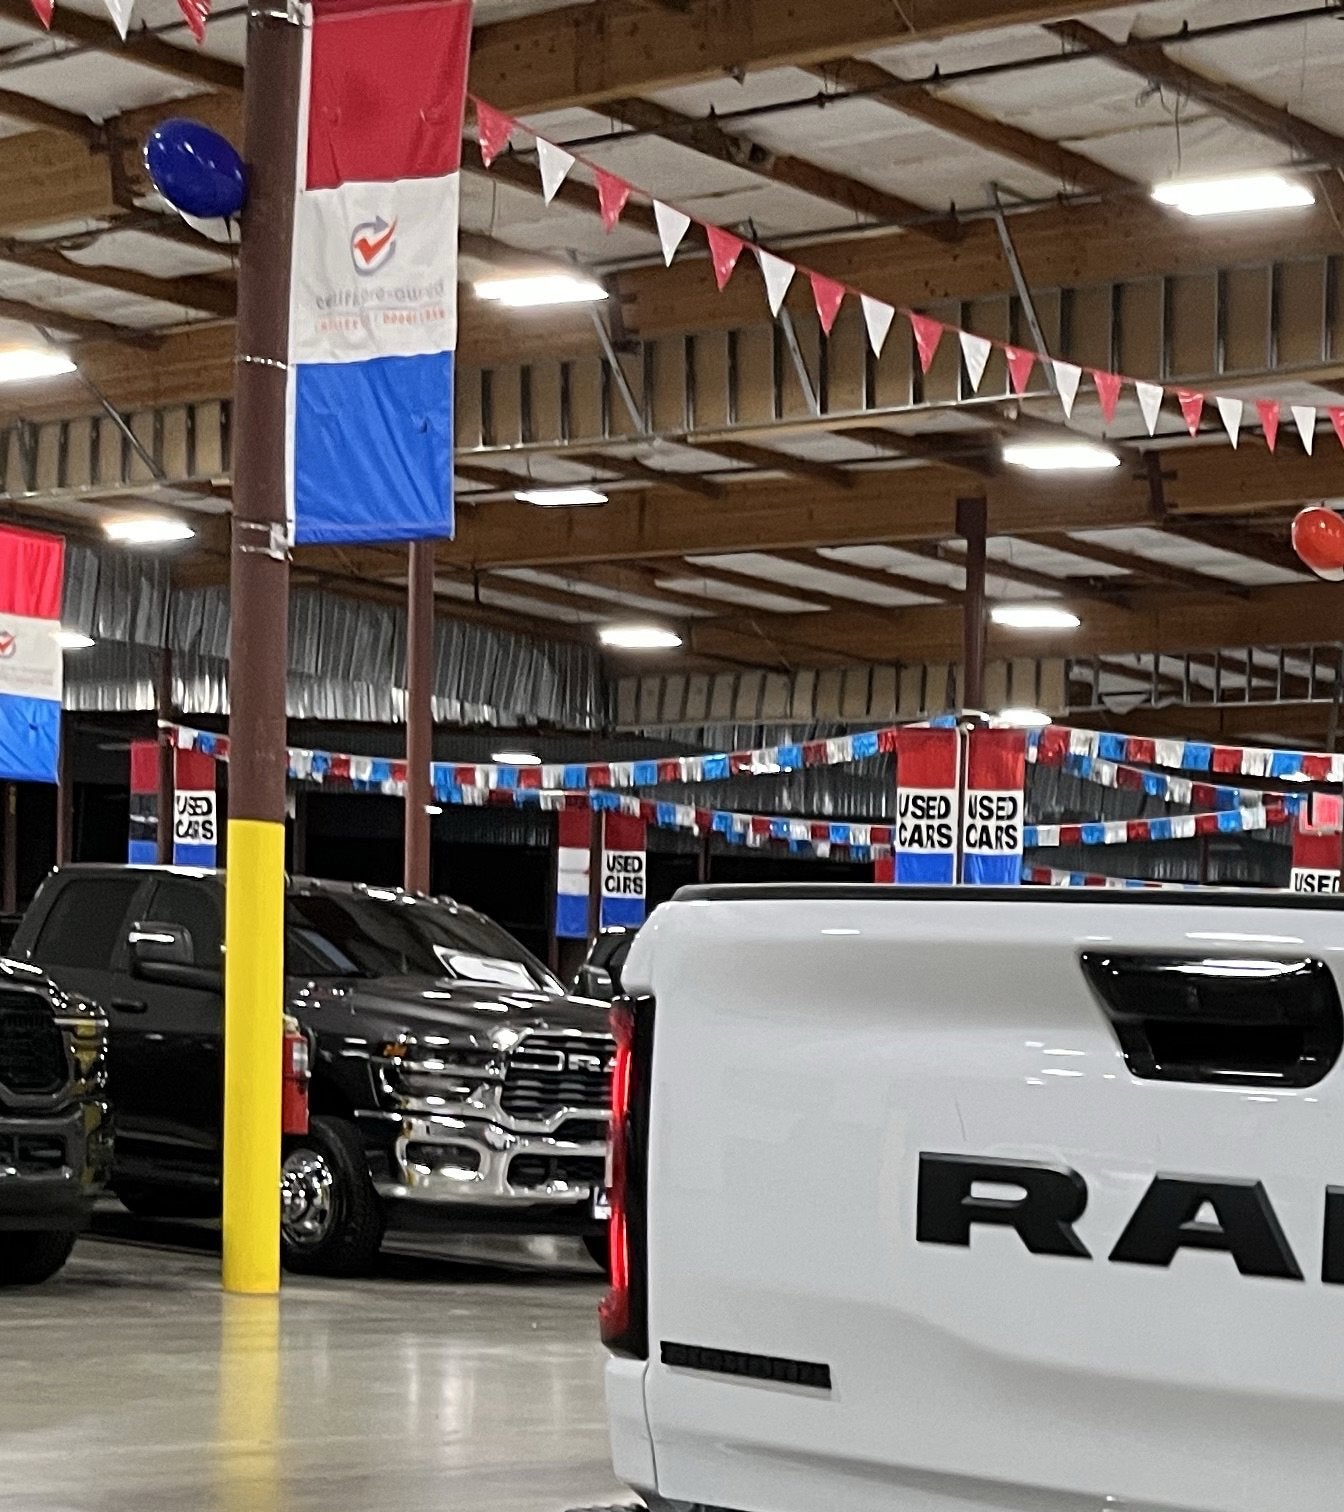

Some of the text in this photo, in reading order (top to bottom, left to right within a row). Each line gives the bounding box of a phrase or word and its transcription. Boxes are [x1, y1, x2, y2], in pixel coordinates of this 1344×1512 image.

[899, 794, 951, 820] USED
[968, 795, 1018, 821] USED
[899, 822, 953, 849] CARS
[965, 823, 1018, 850] CARS
[606, 854, 643, 873] USED
